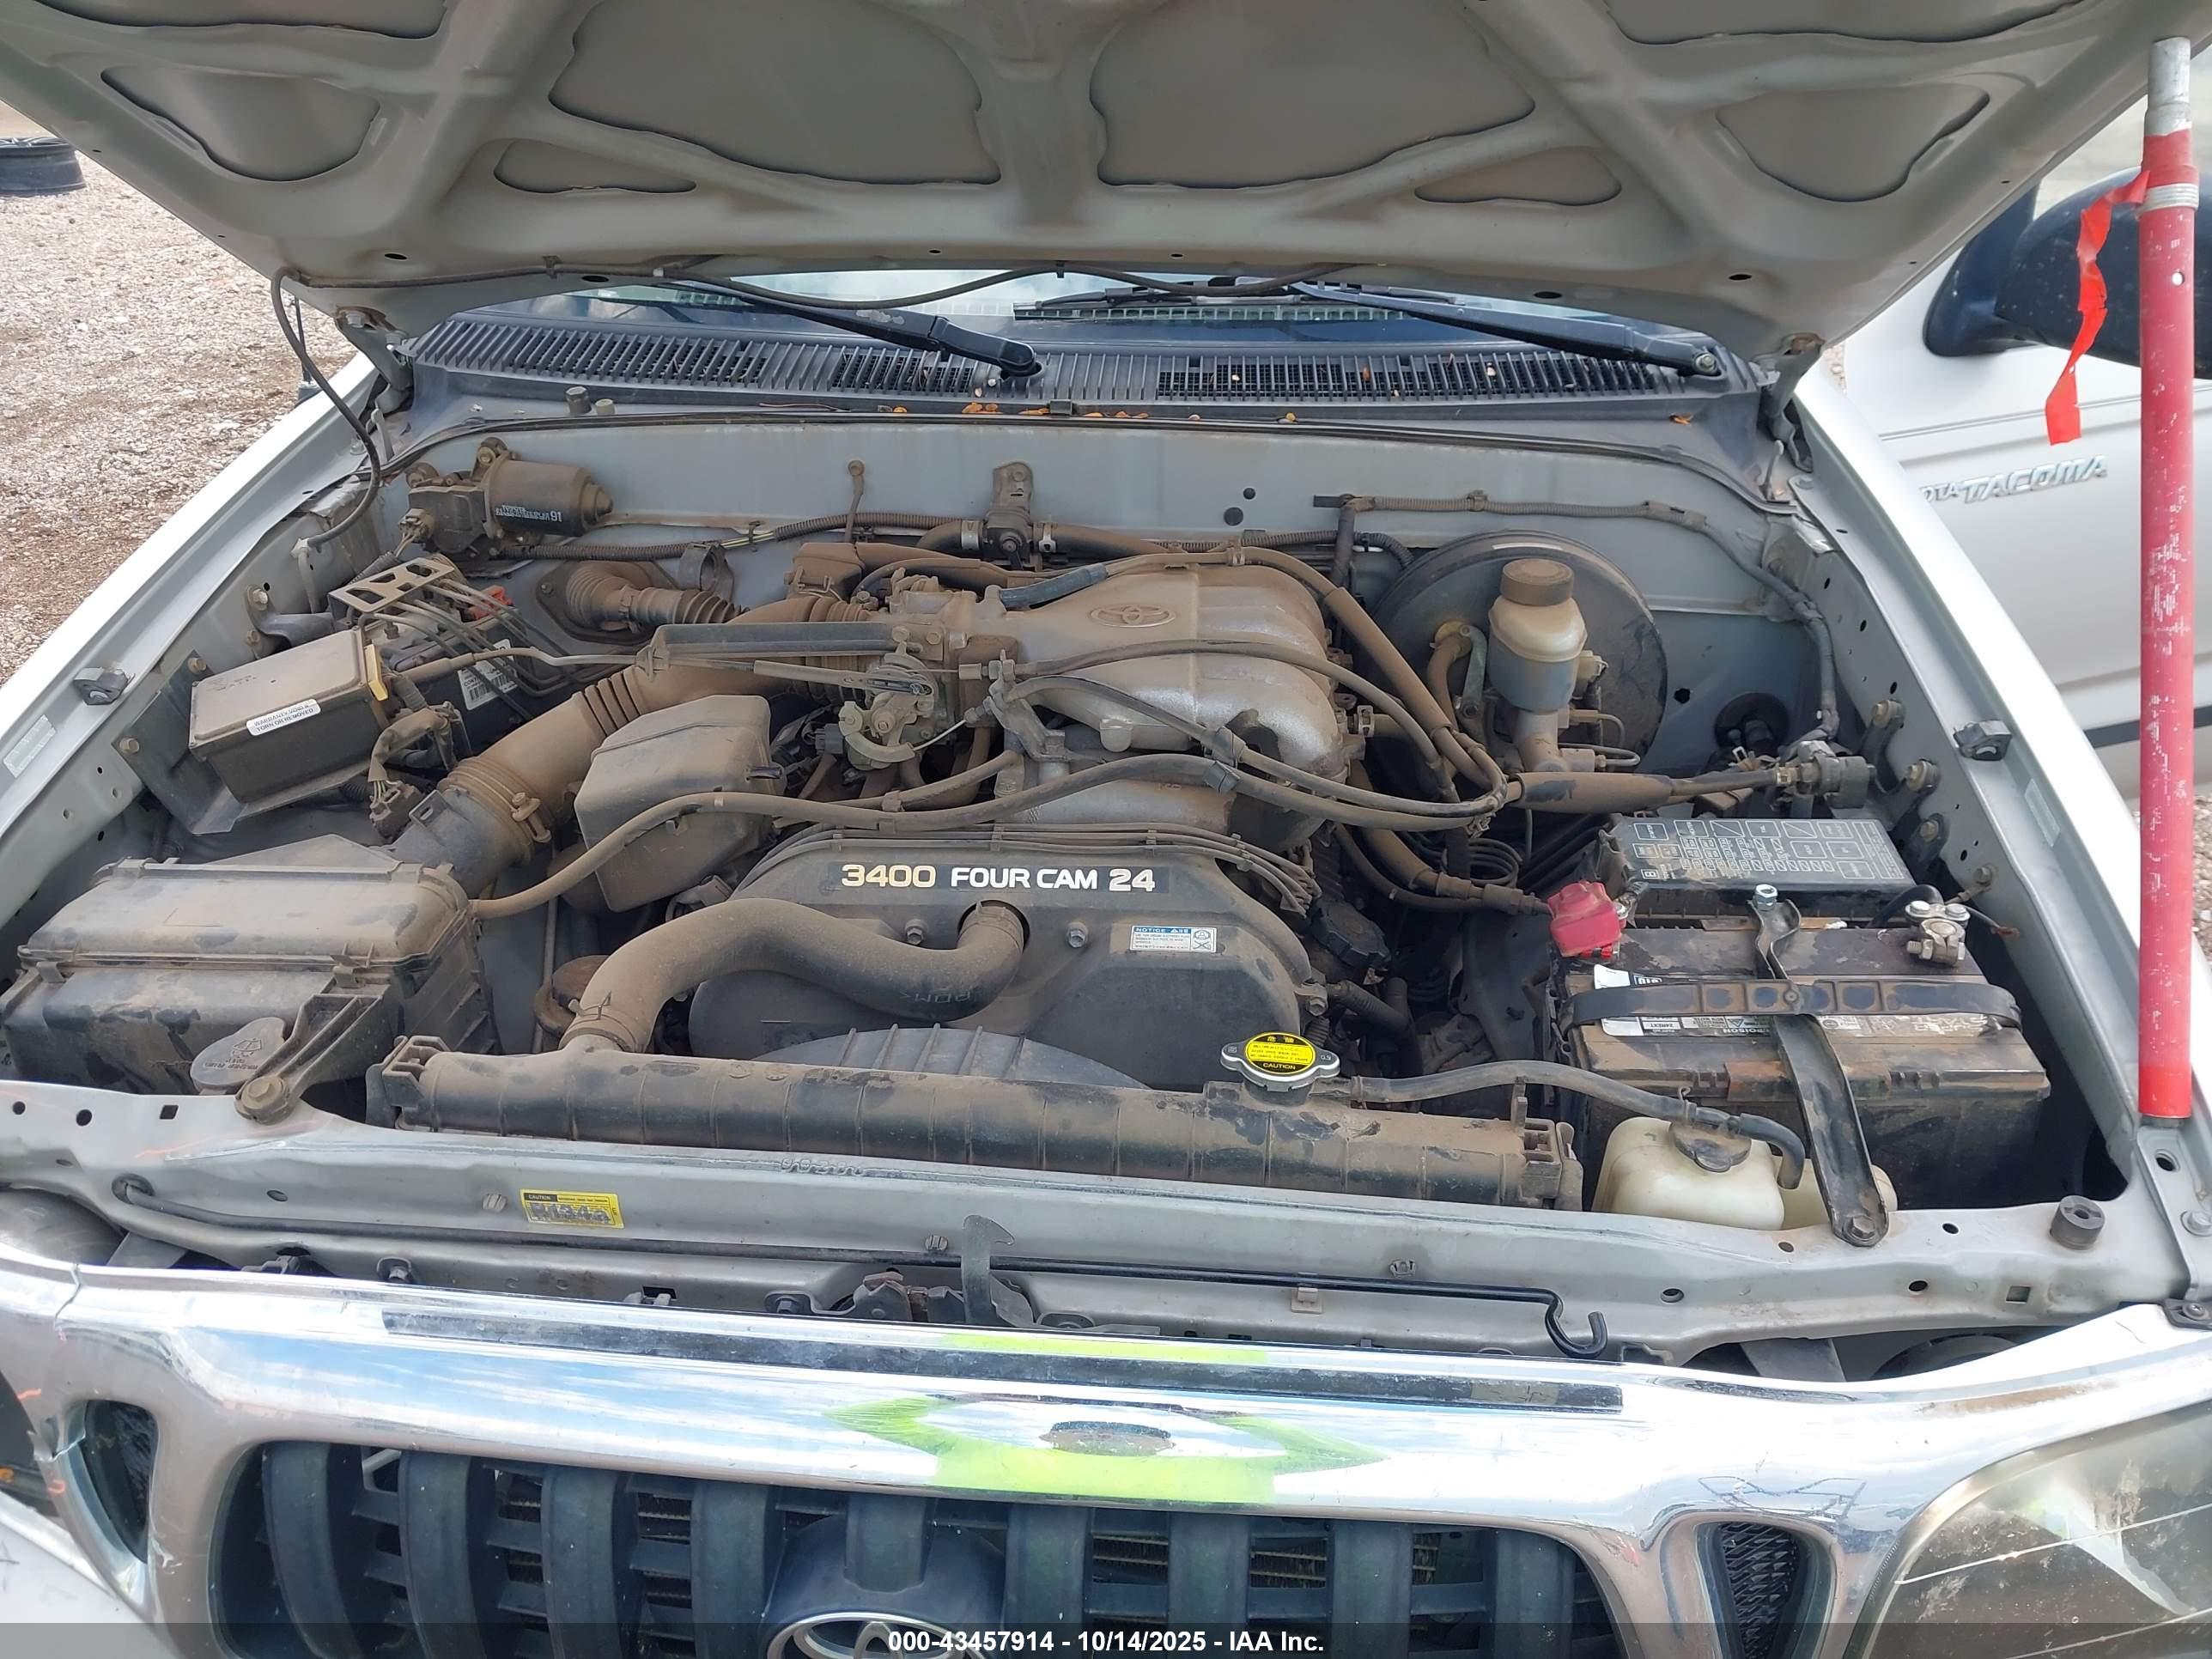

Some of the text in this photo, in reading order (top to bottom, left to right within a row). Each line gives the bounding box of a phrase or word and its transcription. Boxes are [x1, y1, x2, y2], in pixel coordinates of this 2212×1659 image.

[1920, 455, 2106, 504] OTA TACOMA
[257, 723, 275, 732] TORN
[284, 708, 314, 721] REMOVED
[841, 863, 1156, 892] 3400 FOUR CAM 24
